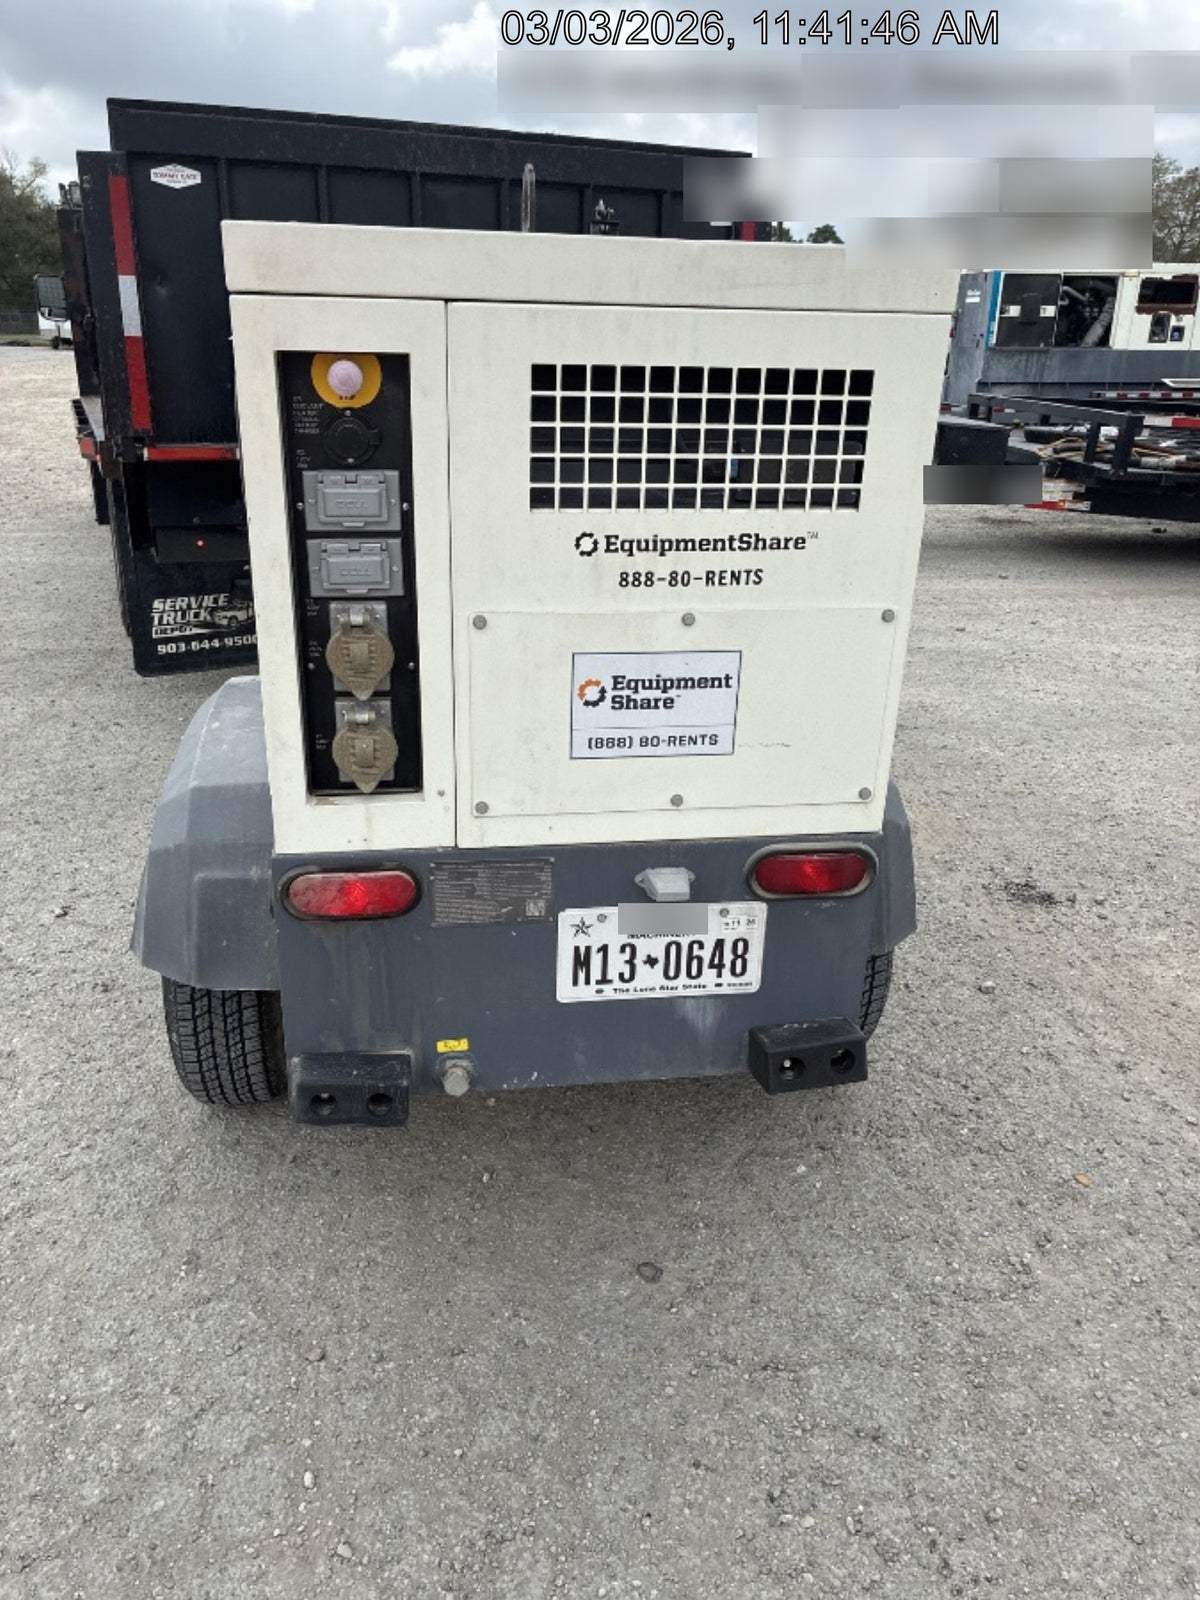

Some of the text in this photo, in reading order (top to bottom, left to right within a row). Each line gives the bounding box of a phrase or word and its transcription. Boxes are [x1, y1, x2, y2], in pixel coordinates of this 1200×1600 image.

[618, 568, 764, 588] 888-80-RENTS
[152, 593, 230, 613] SERVICE
[151, 607, 212, 627] TRUCK
[611, 673, 733, 694] Equipment
[588, 733, 719, 750] (888) 80-RENTS
[572, 936, 750, 987] M13 0648
